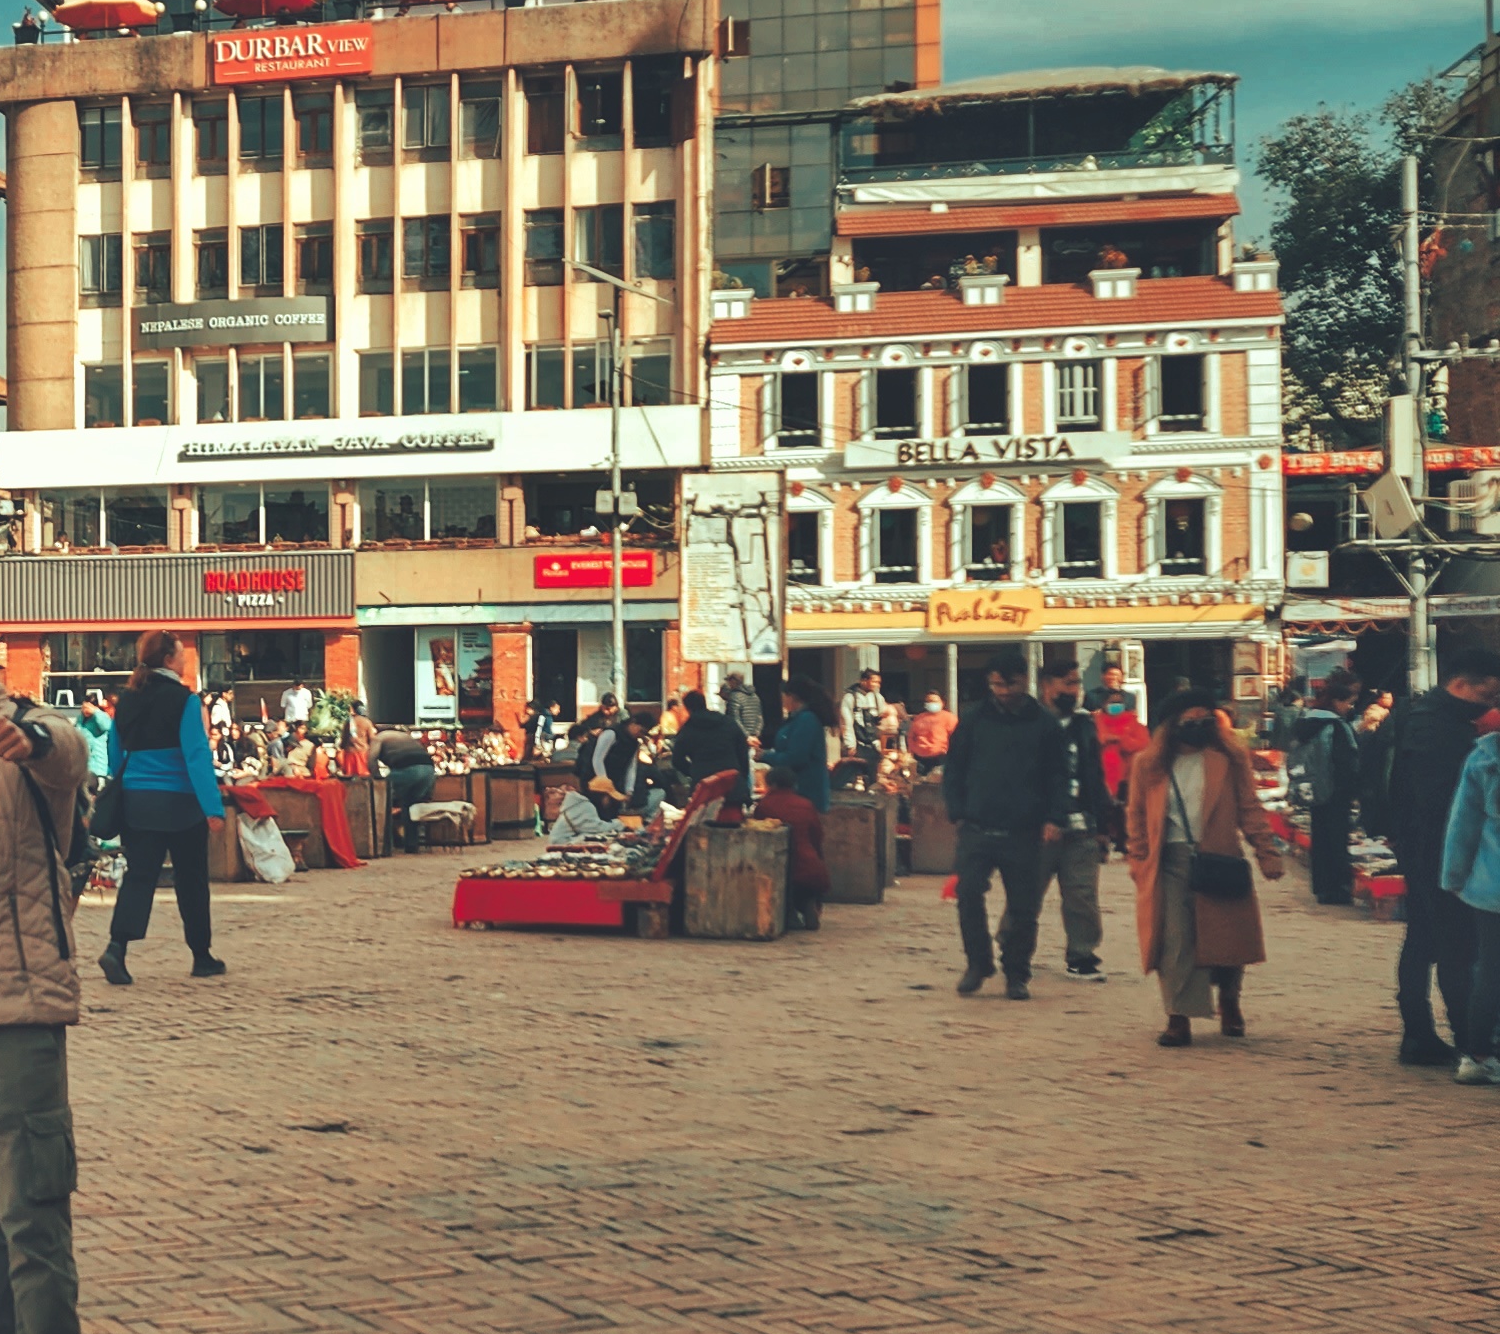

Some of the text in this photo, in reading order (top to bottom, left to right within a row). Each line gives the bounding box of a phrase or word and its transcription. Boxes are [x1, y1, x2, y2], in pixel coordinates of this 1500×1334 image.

[215, 33, 369, 63] DURBAR VIEW
[254, 57, 331, 73] RESTAURANT
[140, 313, 326, 334] NEPALESE ORGANIC COFFEE
[184, 429, 488, 456] HIMALAYAN JAVA COFFEE
[897, 436, 1075, 464] BELLA VISTA
[205, 569, 306, 593] ROADHOUSE
[237, 594, 275, 607] PIZZA
